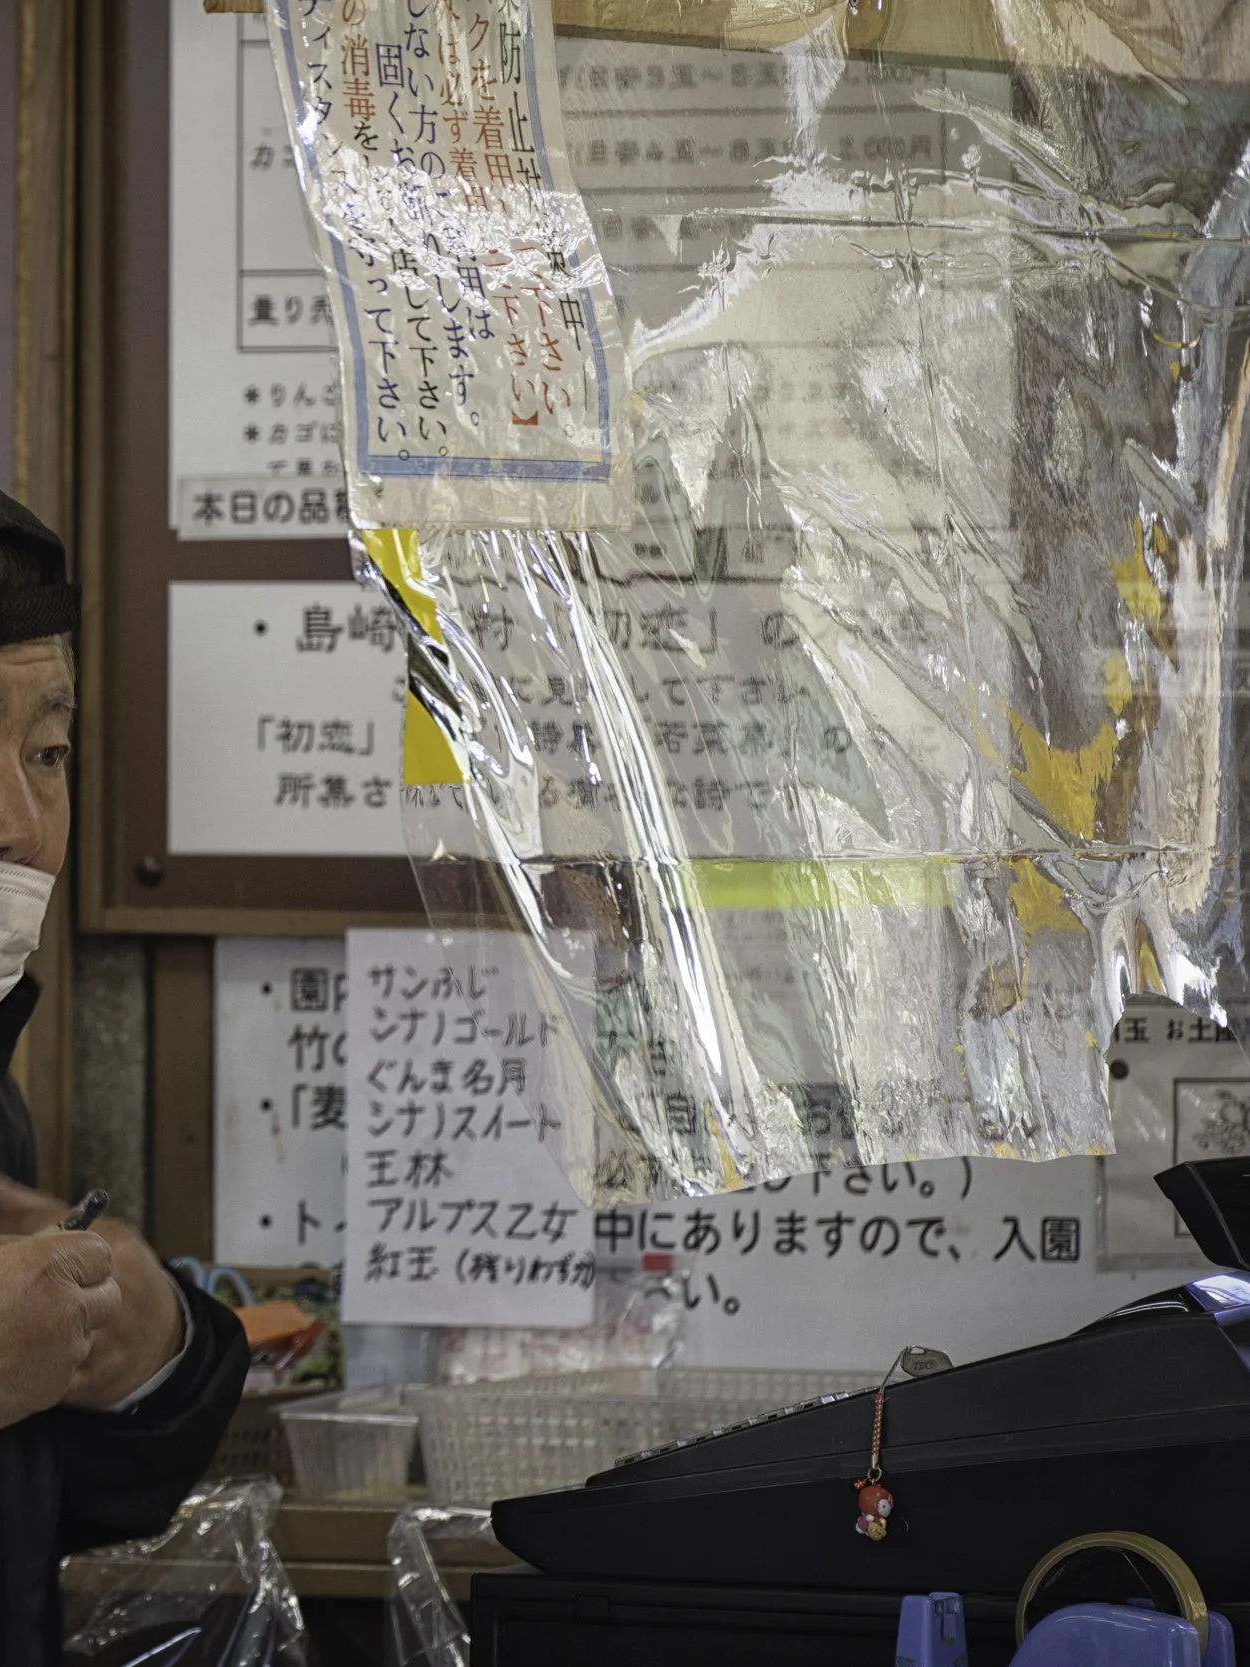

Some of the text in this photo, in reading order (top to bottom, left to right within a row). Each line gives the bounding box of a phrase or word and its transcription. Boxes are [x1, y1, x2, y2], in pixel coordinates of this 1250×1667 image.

[367, 964, 500, 1000] サンふじ
[365, 1057, 528, 1097] ぐんま名月
[367, 1103, 563, 1143] シナノスイート
[365, 1149, 454, 1189] 王林
[367, 1197, 579, 1240] アルプス乙女
[595, 1206, 1081, 1264] 中にありますので、入園
